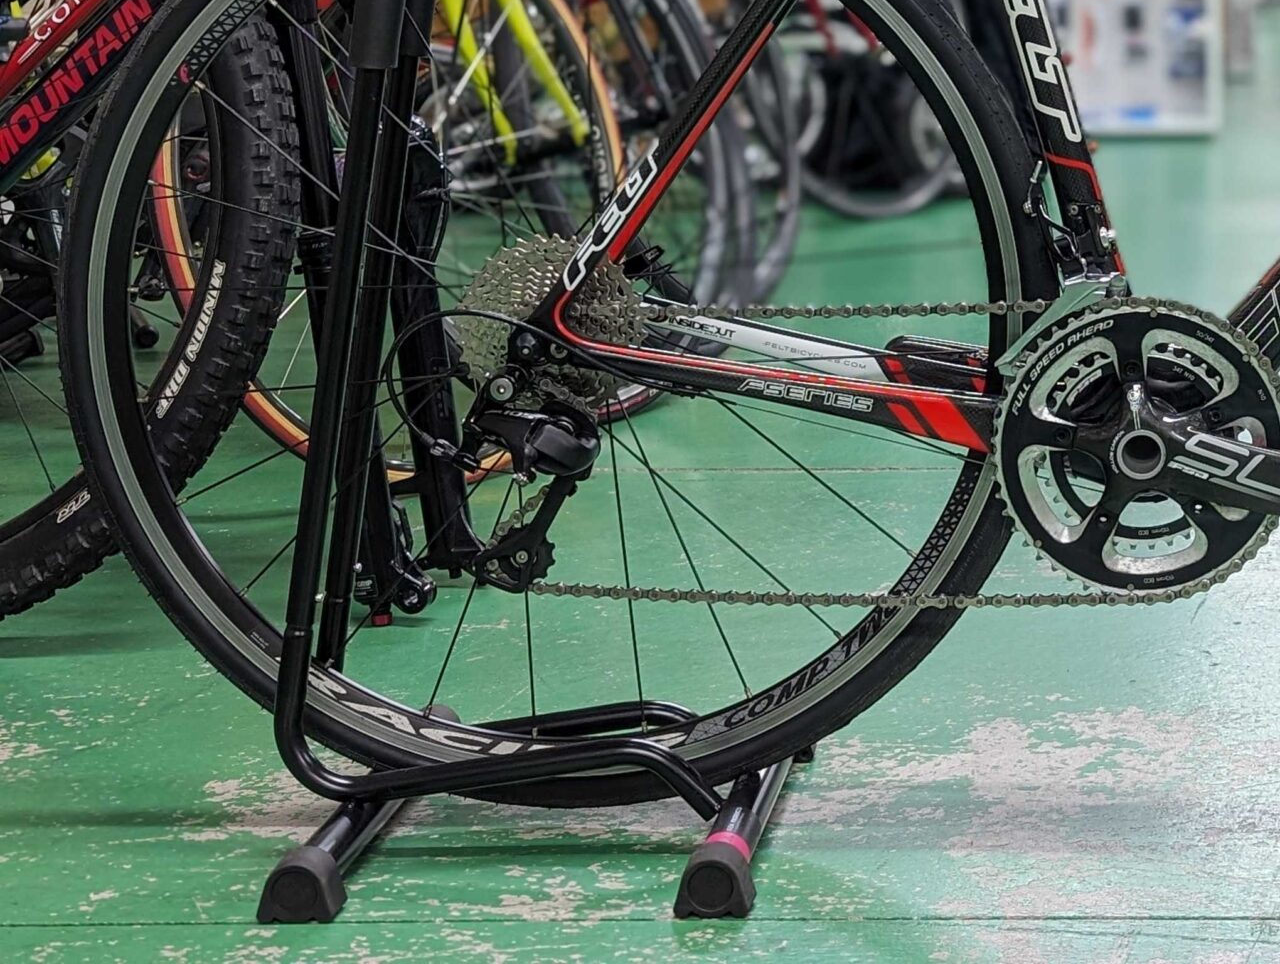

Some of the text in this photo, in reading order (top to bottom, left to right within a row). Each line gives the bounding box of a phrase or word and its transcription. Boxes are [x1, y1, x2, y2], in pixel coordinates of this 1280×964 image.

[563, 139, 660, 292] FELT
[185, 259, 226, 362] MINION
[1011, 319, 1114, 416] FULL SPEED AHEAD
[724, 657, 829, 728] COMP
